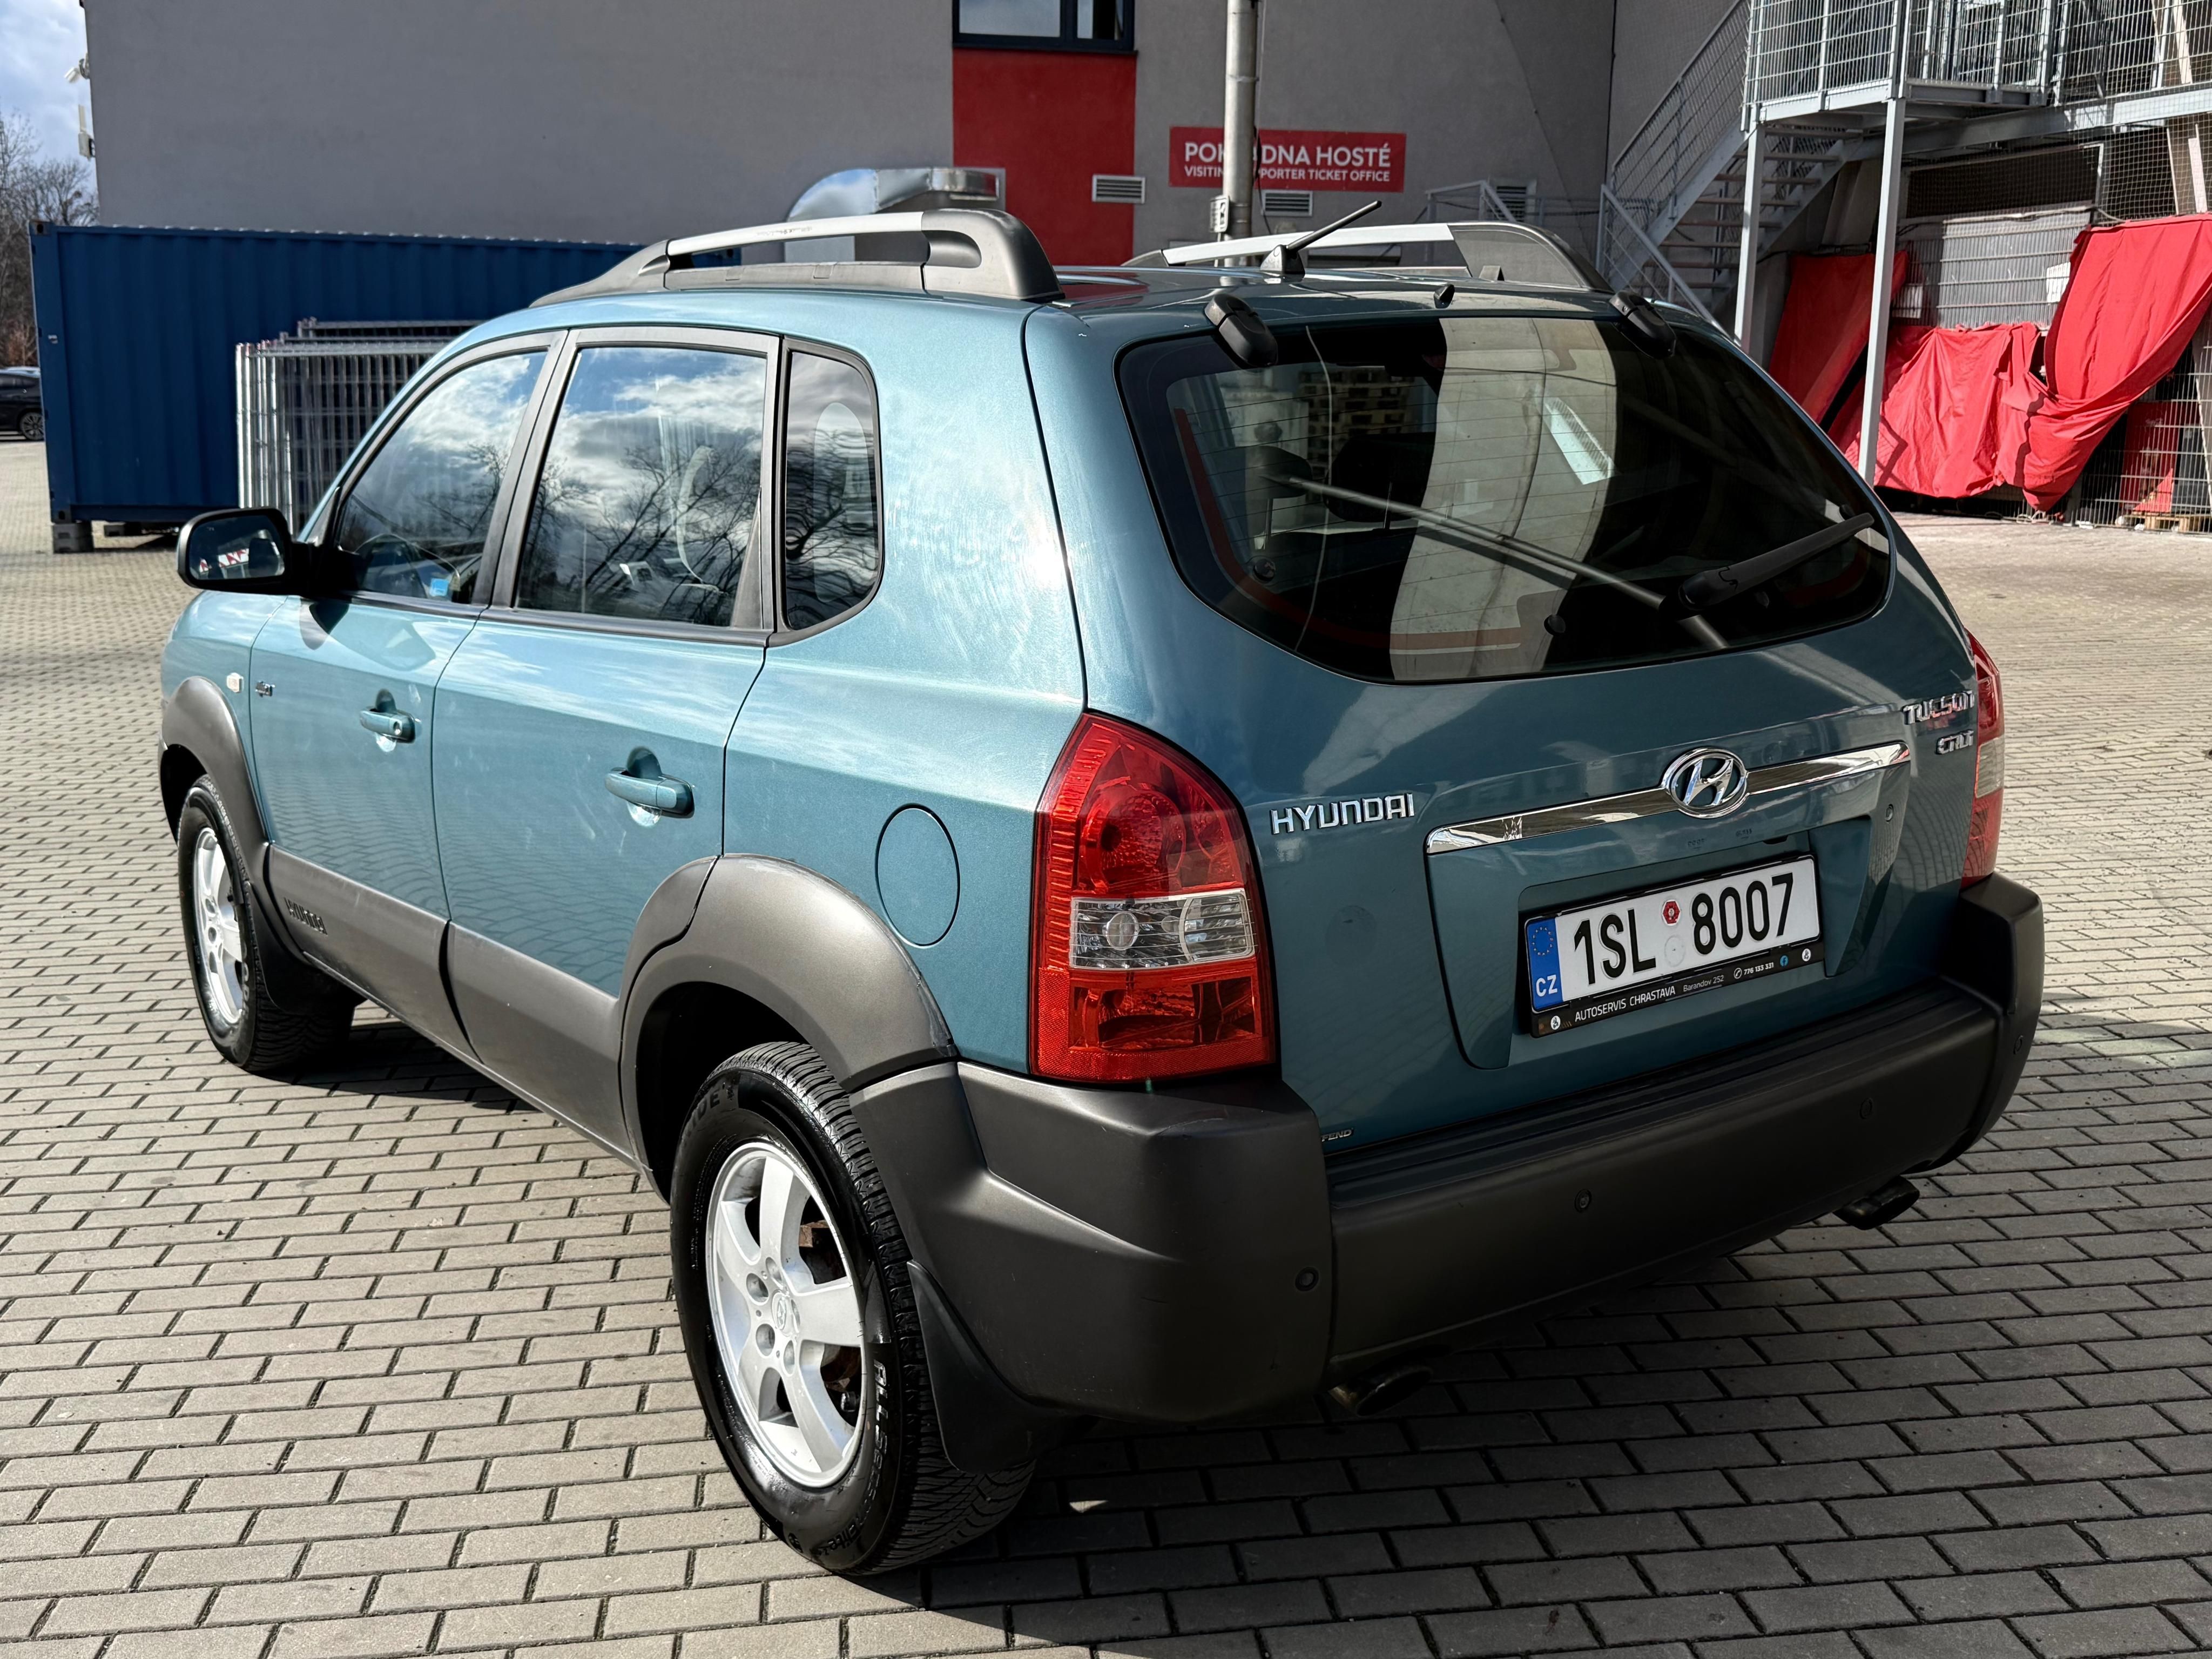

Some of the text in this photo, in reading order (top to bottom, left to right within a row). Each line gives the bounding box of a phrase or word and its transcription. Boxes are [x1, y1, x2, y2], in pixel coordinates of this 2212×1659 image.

[1185, 142, 1391, 167] PODNA HOSTÉ
[1184, 164, 1224, 177] VISITIN
[1308, 169, 1348, 181] TICKET
[1350, 170, 1390, 182] OFFICE
[1902, 690, 1975, 725] TUCSON
[1271, 793, 1415, 835] HYUNDAI
[1574, 872, 1793, 985] 1SL 8007
[1536, 974, 1558, 997] CZ
[1743, 968, 1754, 976] 776
[1575, 975, 1724, 1022] AUTOSERVIS CHRASTAVA Barandov 252
